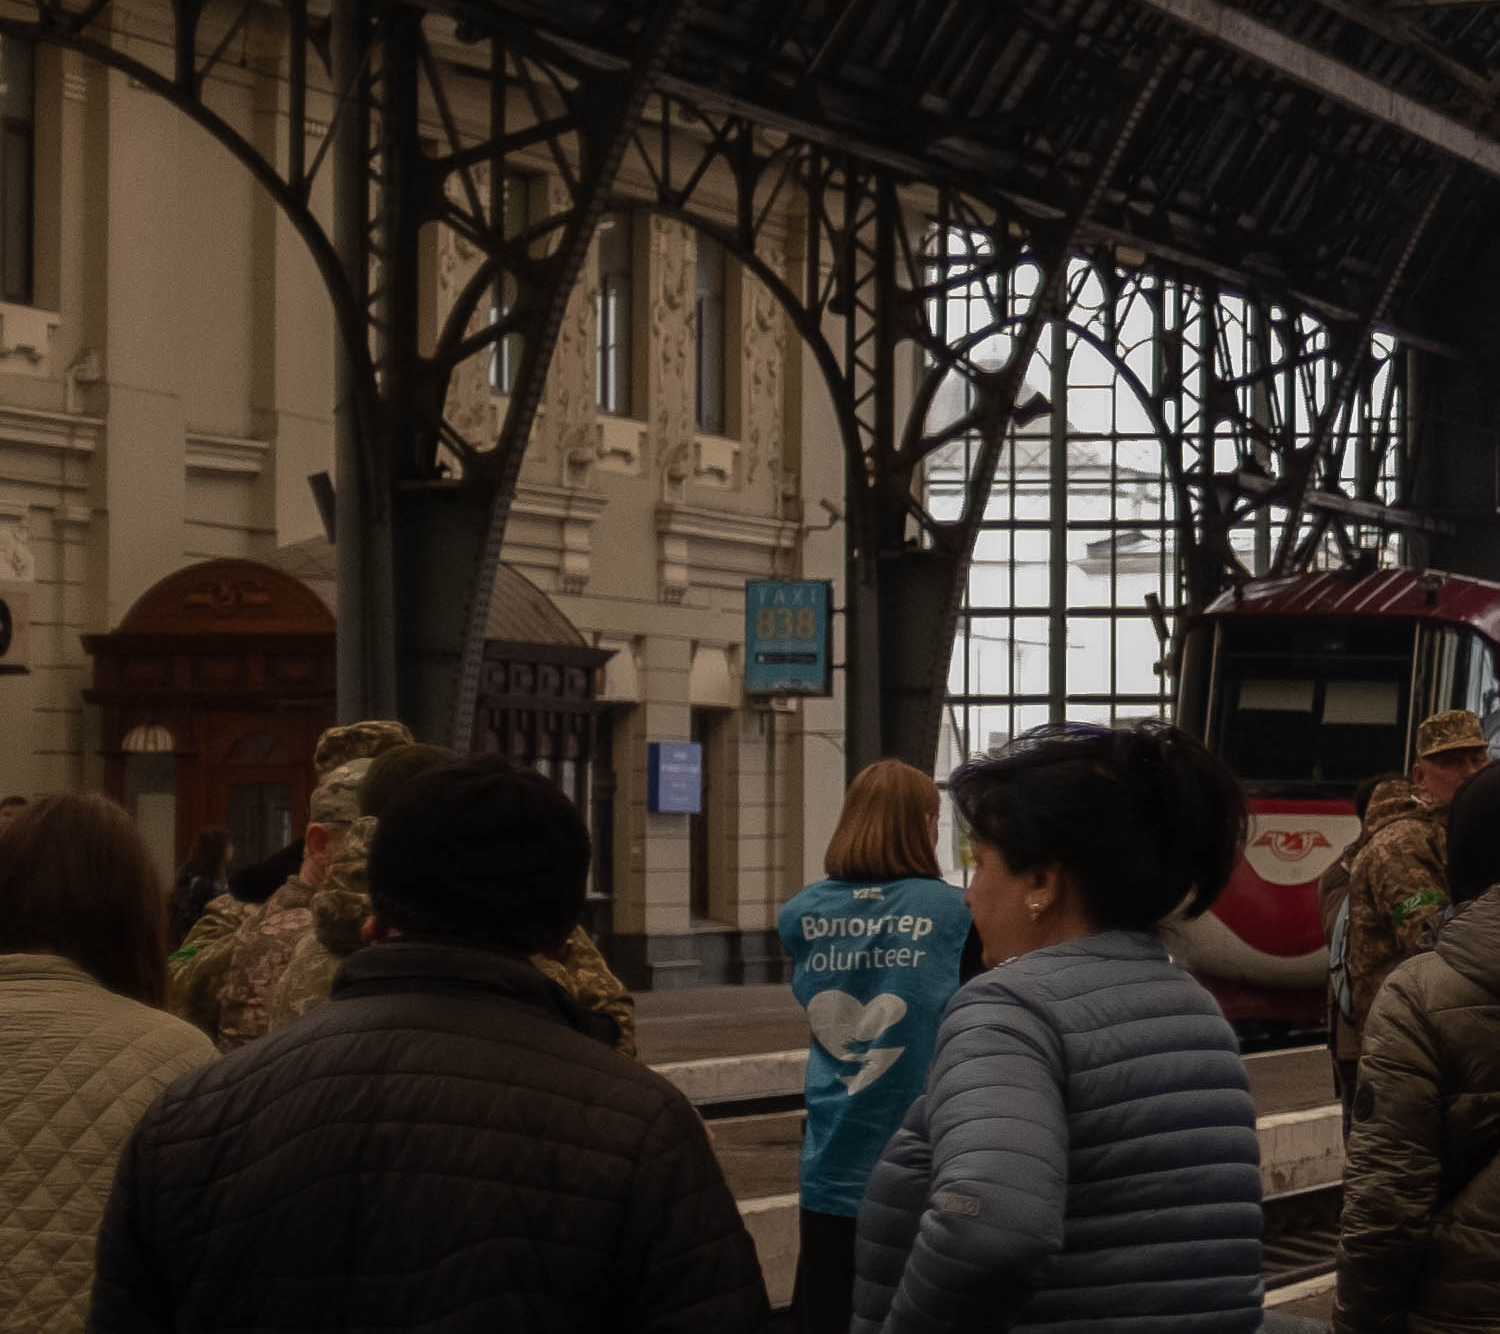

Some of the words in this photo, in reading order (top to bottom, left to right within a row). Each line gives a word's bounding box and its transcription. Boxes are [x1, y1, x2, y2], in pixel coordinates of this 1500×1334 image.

[757, 587, 817, 604] TAXI
[755, 608, 816, 640] 838
[801, 914, 933, 941] Волонтер
